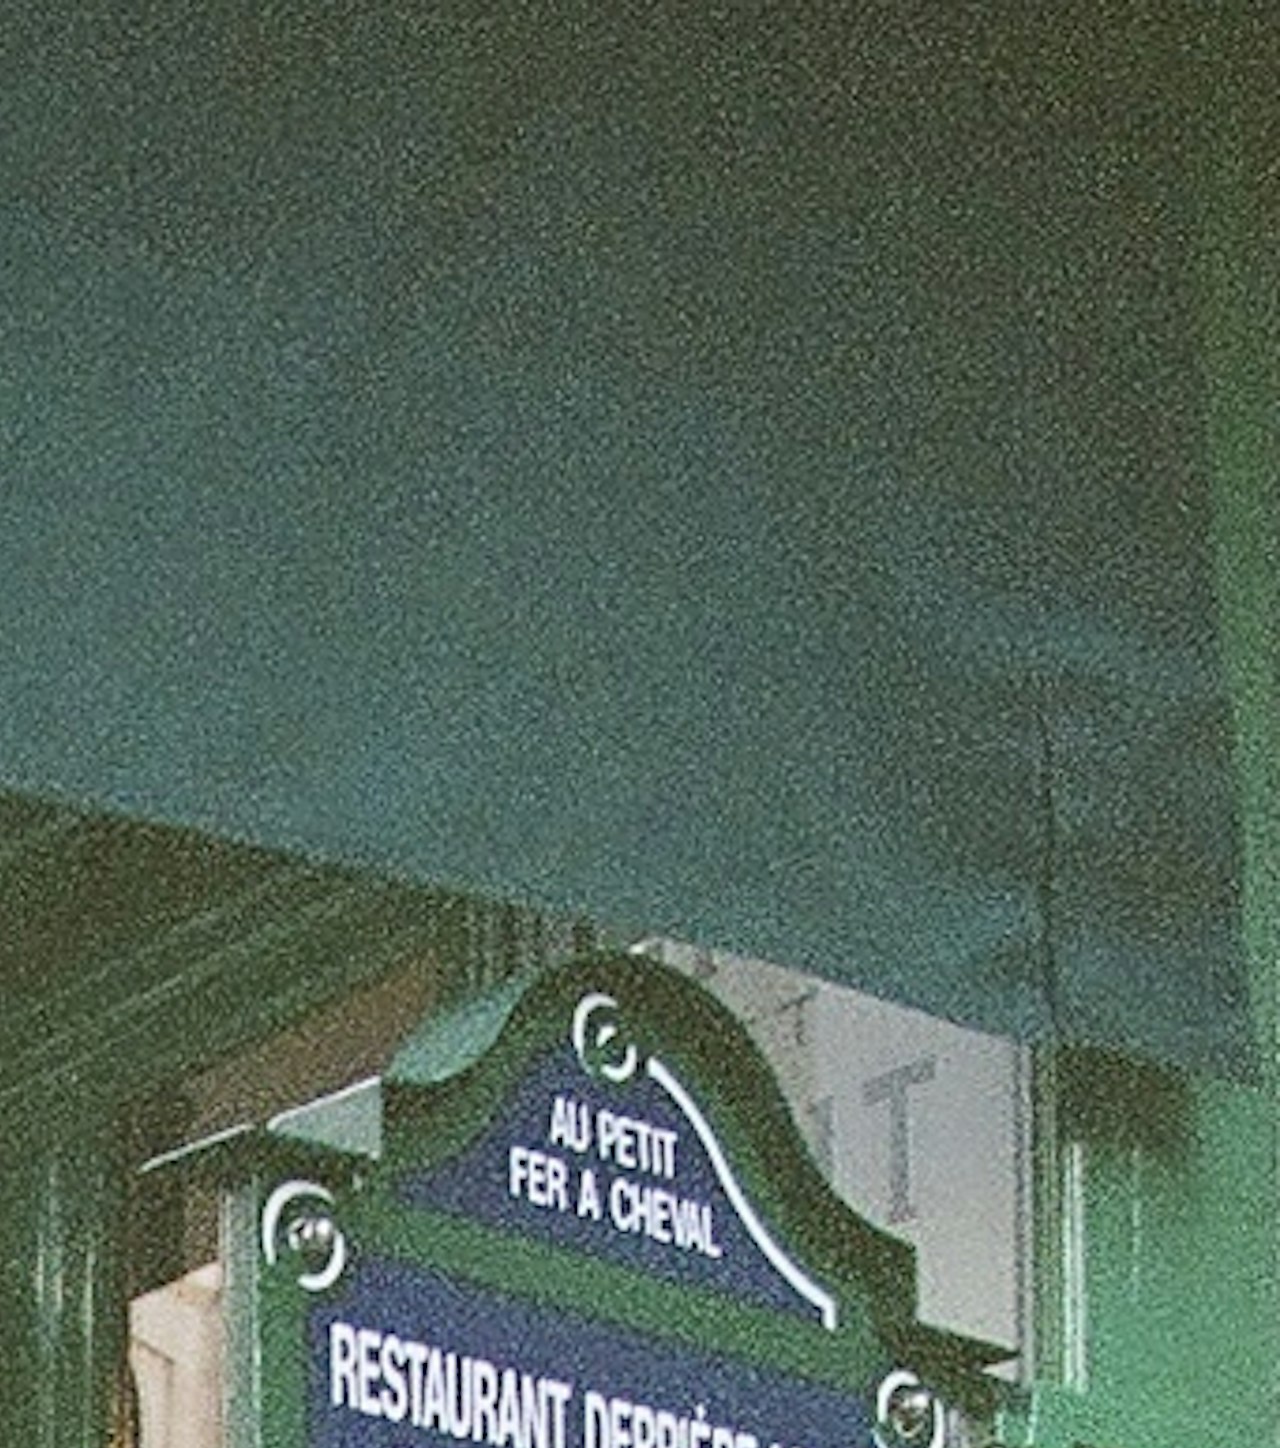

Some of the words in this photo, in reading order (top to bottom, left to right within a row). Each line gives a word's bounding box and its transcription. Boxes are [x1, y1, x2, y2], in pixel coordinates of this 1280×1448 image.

[549, 1097, 589, 1152] AU
[595, 1109, 678, 1180] PETIT
[508, 1146, 568, 1210] FER
[576, 1168, 600, 1221] A
[609, 1179, 722, 1258] CHEVAL
